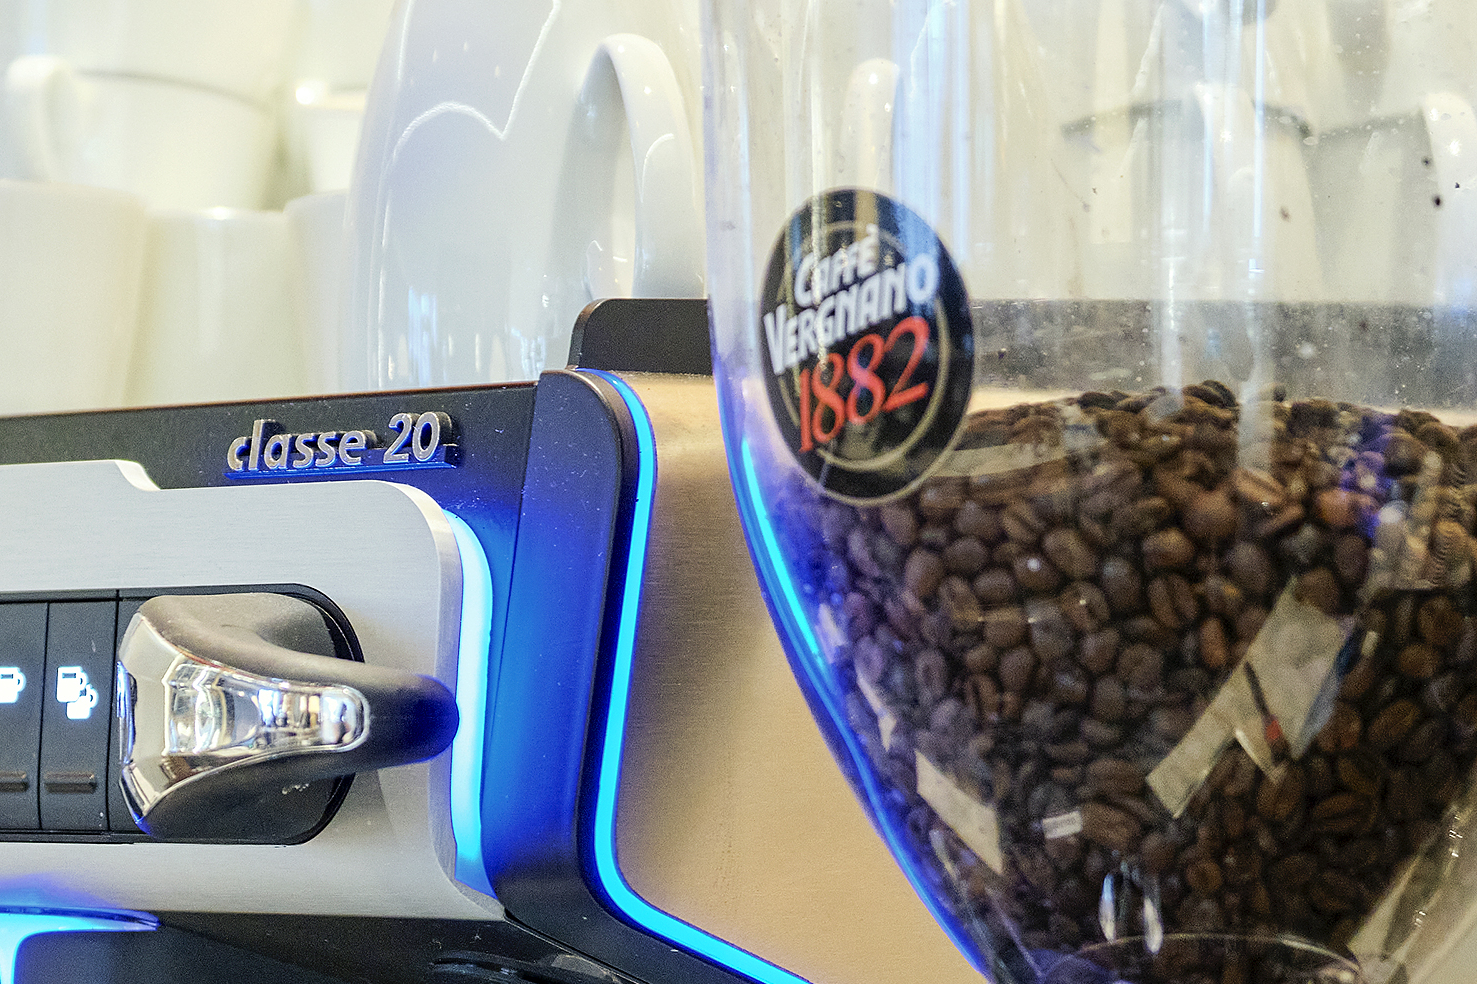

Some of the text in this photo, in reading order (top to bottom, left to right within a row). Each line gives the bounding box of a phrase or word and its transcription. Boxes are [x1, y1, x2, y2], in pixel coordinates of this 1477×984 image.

[763, 253, 940, 376] VERGNANO
[227, 411, 446, 472] classe 20
[798, 316, 930, 453] 1882
